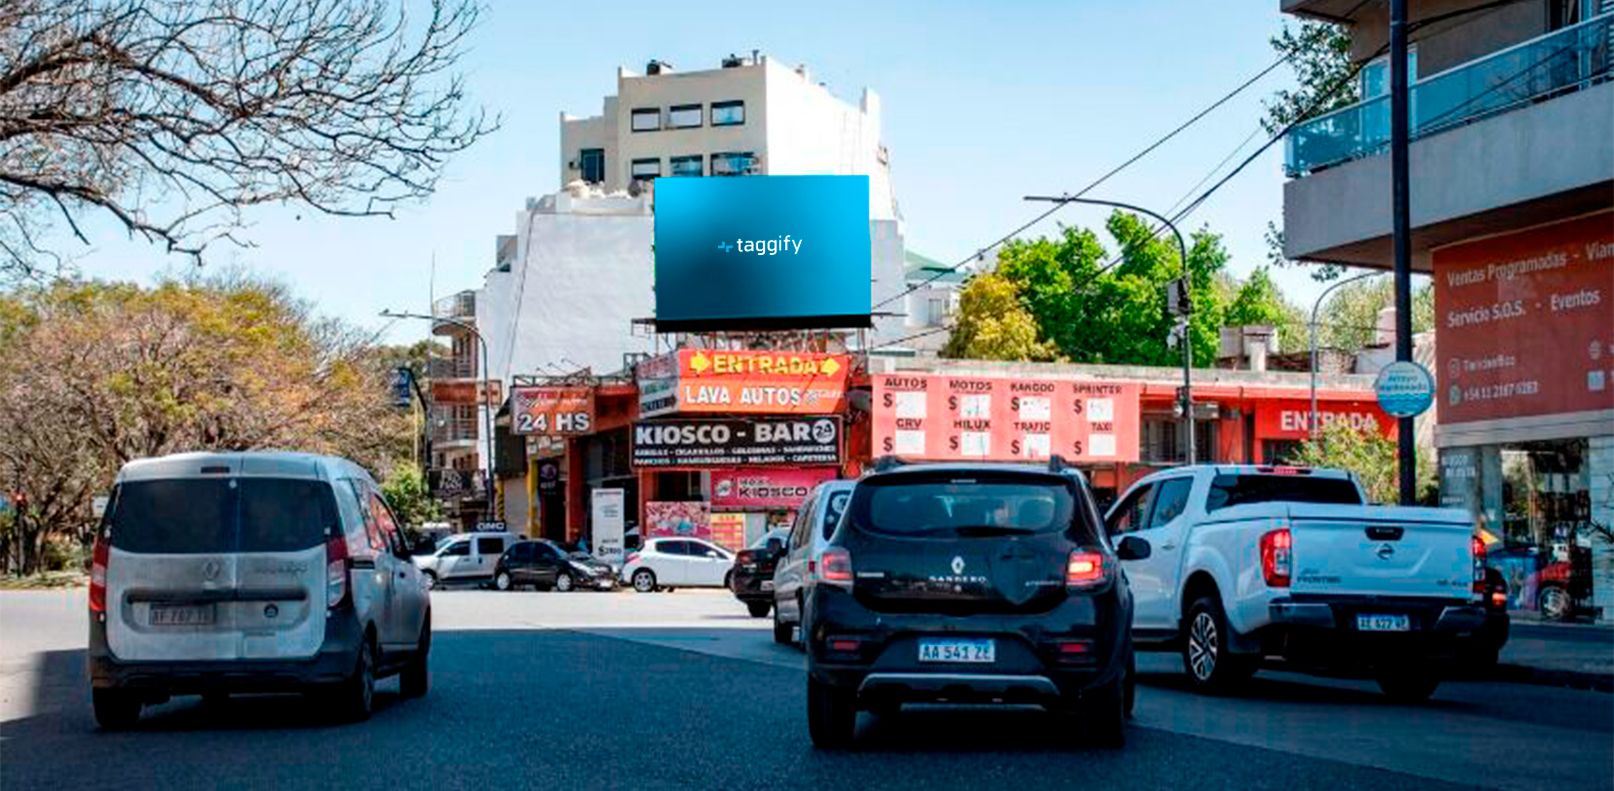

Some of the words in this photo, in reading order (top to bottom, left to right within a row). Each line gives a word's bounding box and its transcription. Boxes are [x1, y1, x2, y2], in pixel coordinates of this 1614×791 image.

[736, 234, 803, 256] taggify
[1447, 269, 1486, 288] Ventas
[1487, 252, 1568, 281] Programadas
[1448, 307, 1489, 328] Servicio
[1492, 300, 1527, 320] S.O.S.
[1551, 289, 1601, 311] Eventos
[713, 354, 818, 375] ENTRADA
[684, 385, 731, 404] LAVA
[739, 387, 801, 406] AUTOS
[884, 377, 928, 390] AUTOS
[949, 380, 992, 391] MOTOS
[1010, 382, 1055, 393] KANGOO
[1072, 383, 1122, 394] SPRINTER
[882, 393, 893, 408] $
[948, 395, 958, 411] $
[1010, 396, 1020, 412] $
[1073, 398, 1083, 415] $
[519, 412, 547, 431] 24
[555, 412, 590, 431] HS
[953, 419, 991, 430] HILUX
[1013, 421, 1051, 432] TRAFIC
[1090, 422, 1113, 432] TAXI
[634, 425, 731, 445] KIOSCO
[754, 421, 812, 443] BAR
[883, 436, 893, 452] $
[949, 435, 959, 451] $
[1010, 438, 1020, 455] $
[1073, 440, 1082, 455] $
[738, 487, 809, 499] KIOSCO
[922, 645, 940, 660] AA
[943, 645, 970, 660] 541
